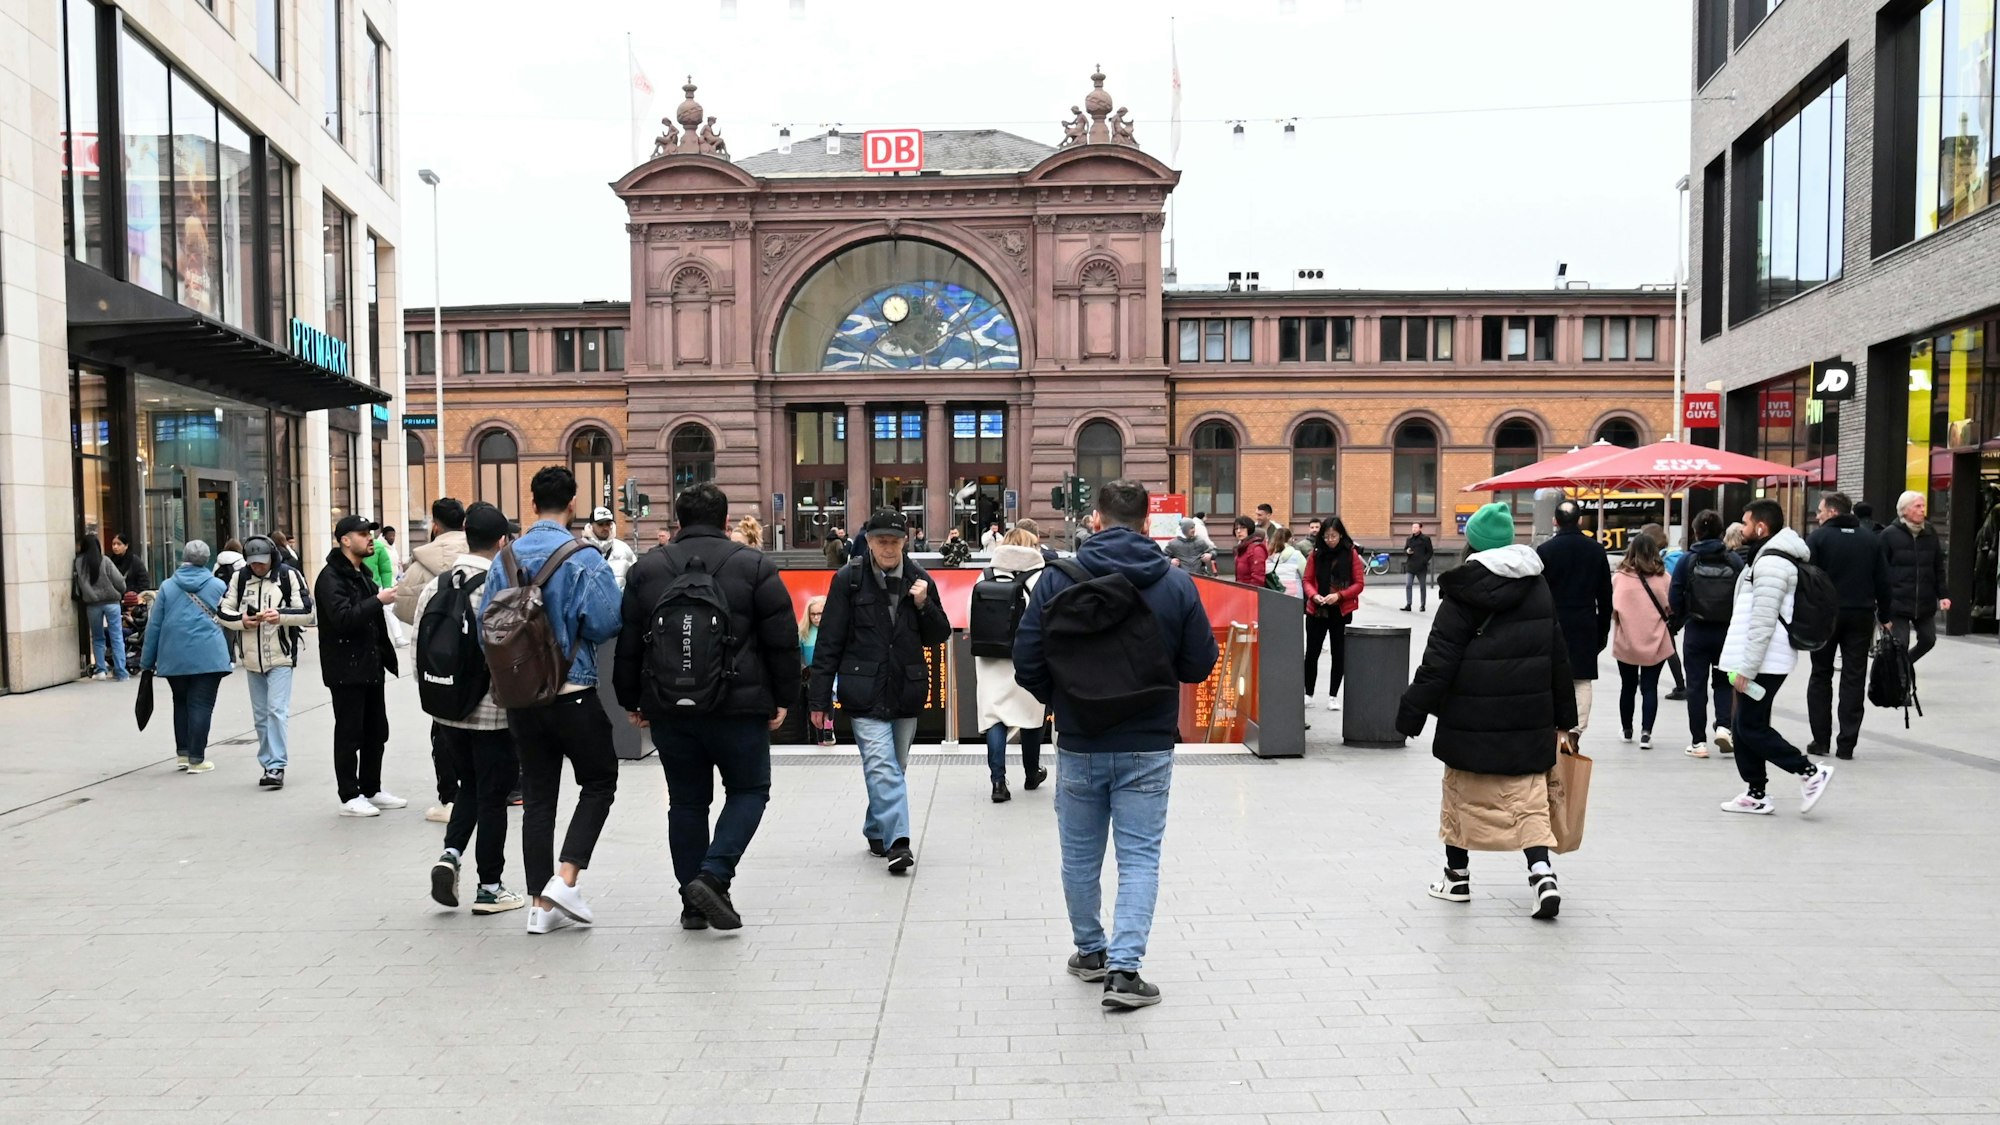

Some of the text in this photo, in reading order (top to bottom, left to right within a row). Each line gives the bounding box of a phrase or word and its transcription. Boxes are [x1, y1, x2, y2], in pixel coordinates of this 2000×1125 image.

[872, 136, 915, 165] DB
[293, 317, 348, 377] PRIMARK
[1816, 369, 1849, 392] JD
[1686, 410, 1717, 419] GUYS
[1689, 402, 1714, 410] FIVE
[682, 614, 693, 671] JUST GET IT.
[424, 671, 454, 685] hummel
